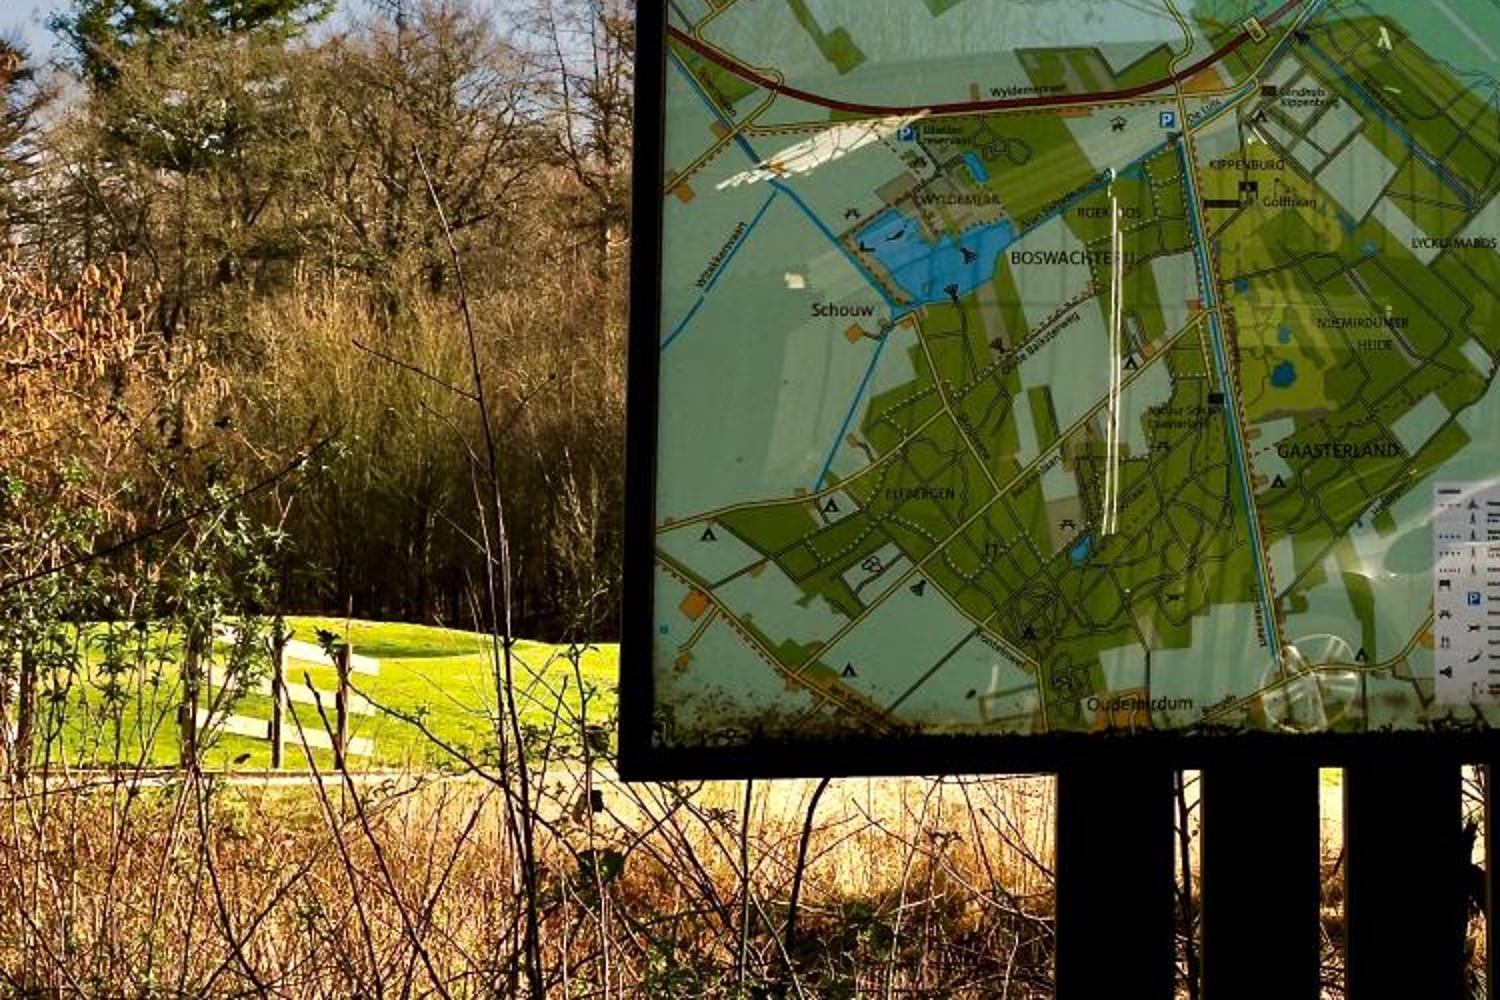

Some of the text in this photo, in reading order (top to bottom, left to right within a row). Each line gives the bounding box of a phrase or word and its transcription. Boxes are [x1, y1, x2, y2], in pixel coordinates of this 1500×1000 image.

[811, 302, 875, 317] Schouw
[1277, 443, 1402, 458] GAASTERLAND
[1087, 696, 1193, 712] Oudemirdum
